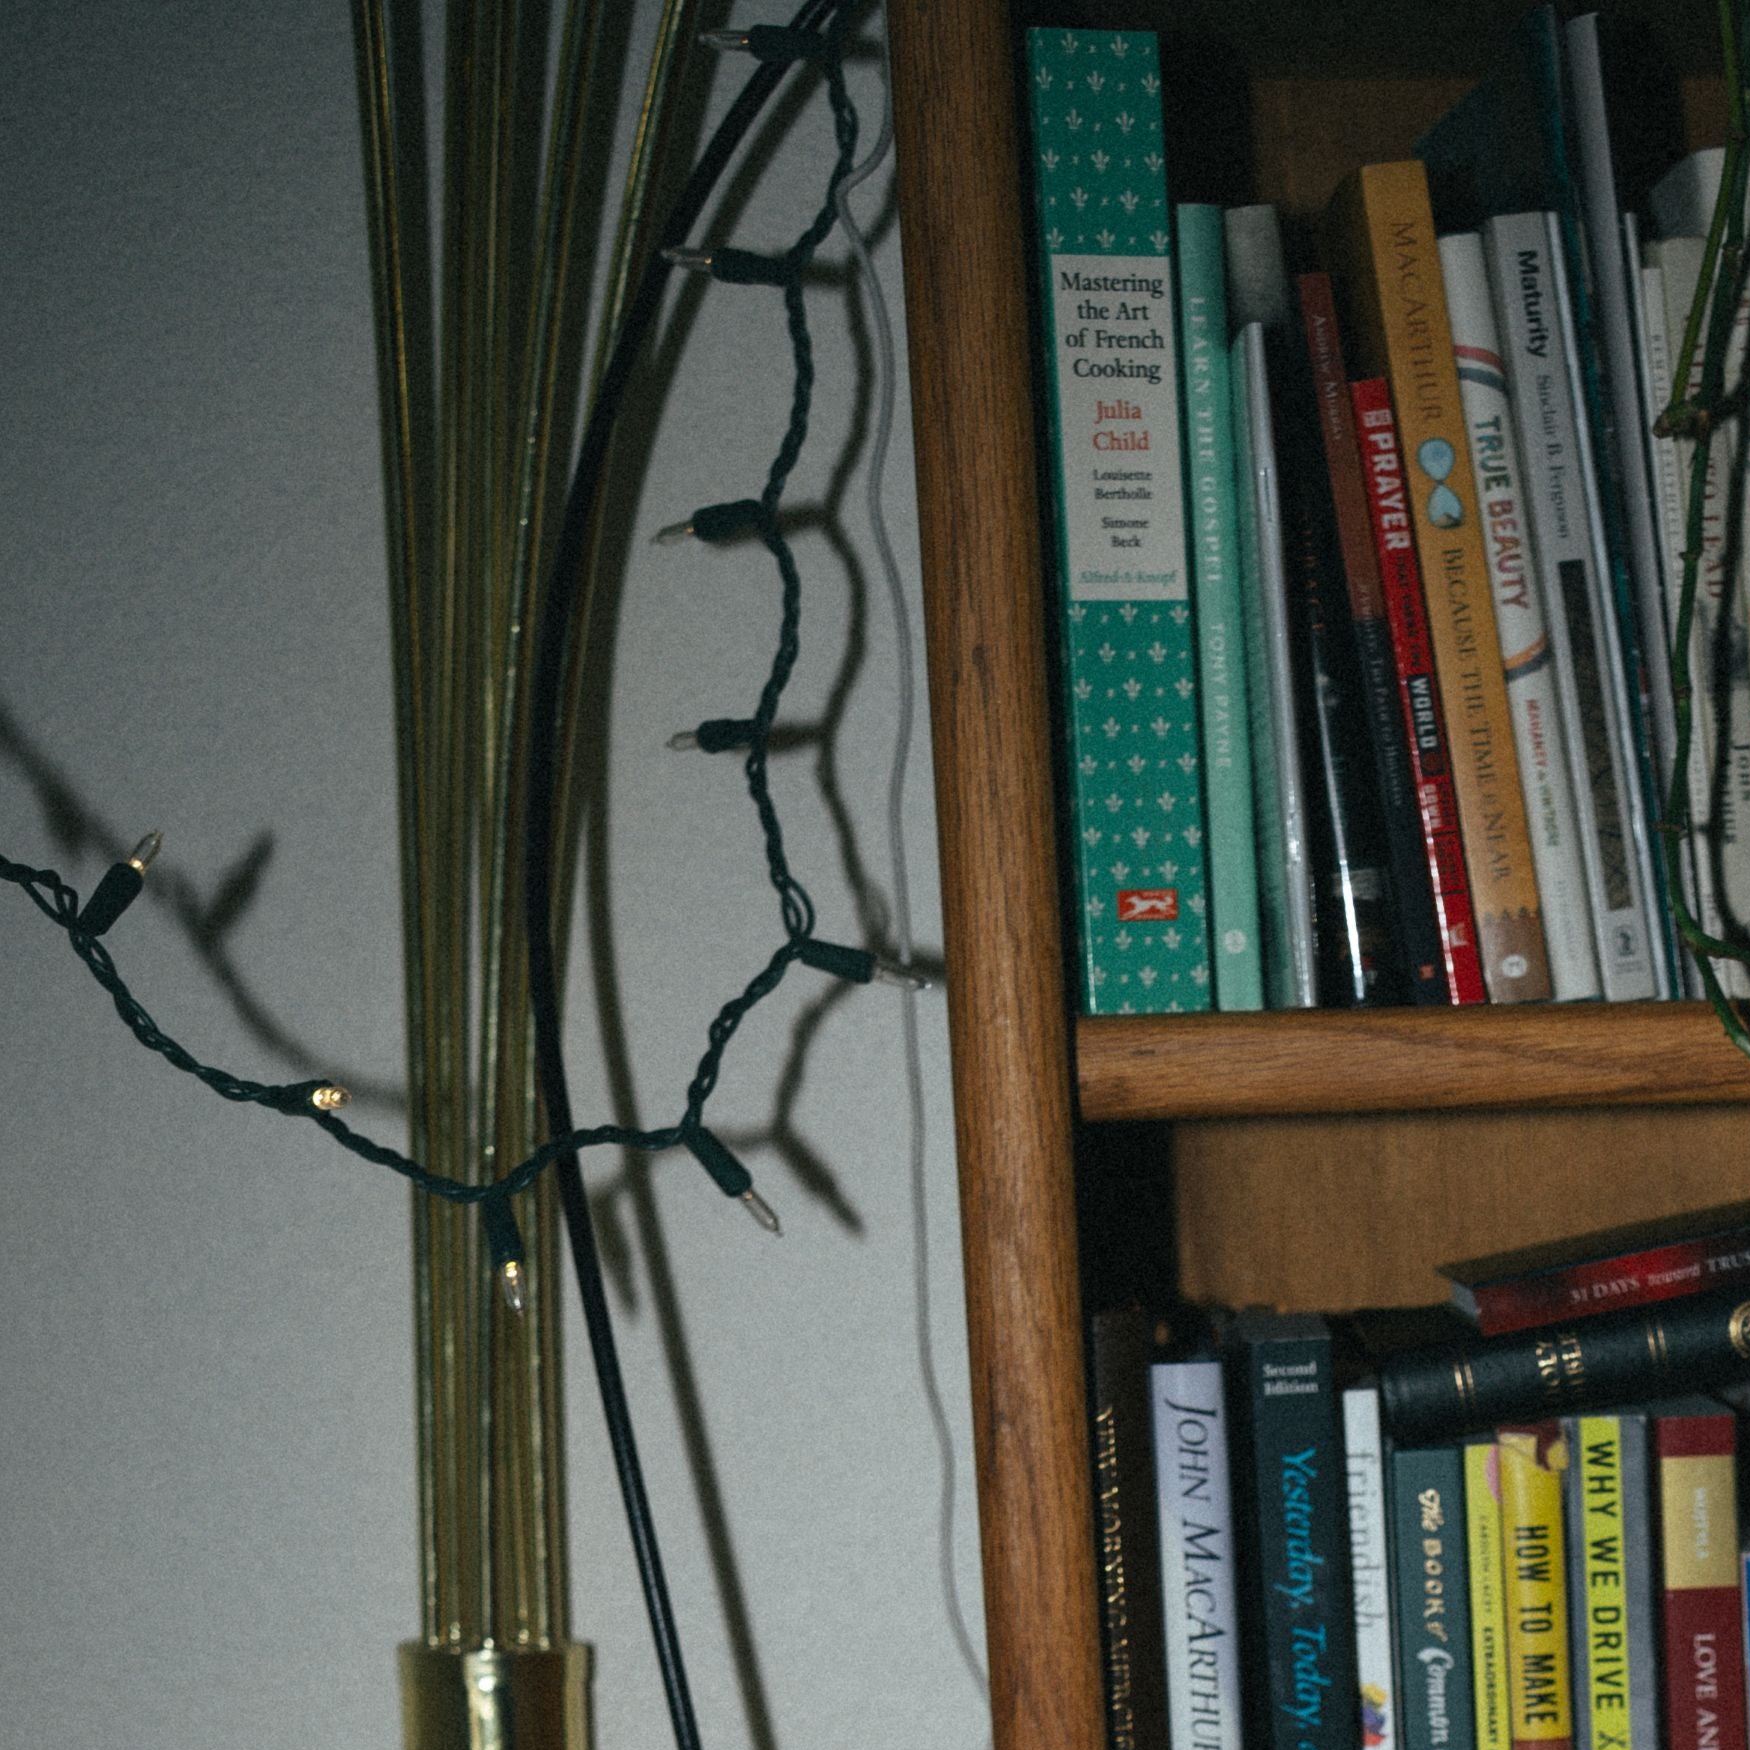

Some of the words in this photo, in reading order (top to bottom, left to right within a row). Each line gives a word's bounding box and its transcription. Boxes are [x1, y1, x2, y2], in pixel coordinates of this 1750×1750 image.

[1060, 272, 1163, 298] Mastering
[1078, 302, 1108, 320] the
[1116, 302, 1148, 320] Art
[1517, 250, 1550, 358] Maturity
[1066, 330, 1086, 348] of
[1095, 330, 1164, 349] French
[1072, 358, 1161, 384] Cooking
[1189, 298, 1212, 395] LEARN
[1095, 400, 1142, 424] Julia
[1195, 406, 1217, 458] THE
[1535, 374, 1560, 436] Sinclair
[1093, 432, 1149, 450] Child
[1474, 416, 1511, 491] TRUE
[1200, 477, 1222, 586] GOSPEL
[1544, 464, 1572, 538] Ferguson
[1111, 535, 1142, 548] Beck
[1488, 500, 1530, 610] BEAUTY
[1368, 432, 1411, 550] PRAYER
[1411, 676, 1439, 749] WORLD
[1442, 549, 1476, 660] BECAUSE
[1463, 666, 1485, 720] THE
[1212, 694, 1231, 769] PAYNE
[1470, 720, 1495, 785] TIME
[1485, 802, 1512, 881] NEAR
[1570, 1288, 1588, 1304] 31
[1592, 1275, 1640, 1299] DAYS
[1162, 1399, 1218, 1502] JOHN
[1586, 1440, 1616, 1520] WHY
[1273, 1446, 1326, 1610] Yesterday,
[1418, 1489, 1444, 1532] The
[1423, 1538, 1446, 1618] BOOK
[1516, 1526, 1552, 1582] HOW
[1590, 1536, 1619, 1590] WE
[1519, 1602, 1554, 1634] TO
[1280, 1623, 1332, 1729] Today,
[1524, 1654, 1558, 1725] MAKE
[1592, 1606, 1624, 1712] DRIVE
[1693, 1632, 1718, 1700] LOVE
[1416, 1647, 1454, 1744] Common
